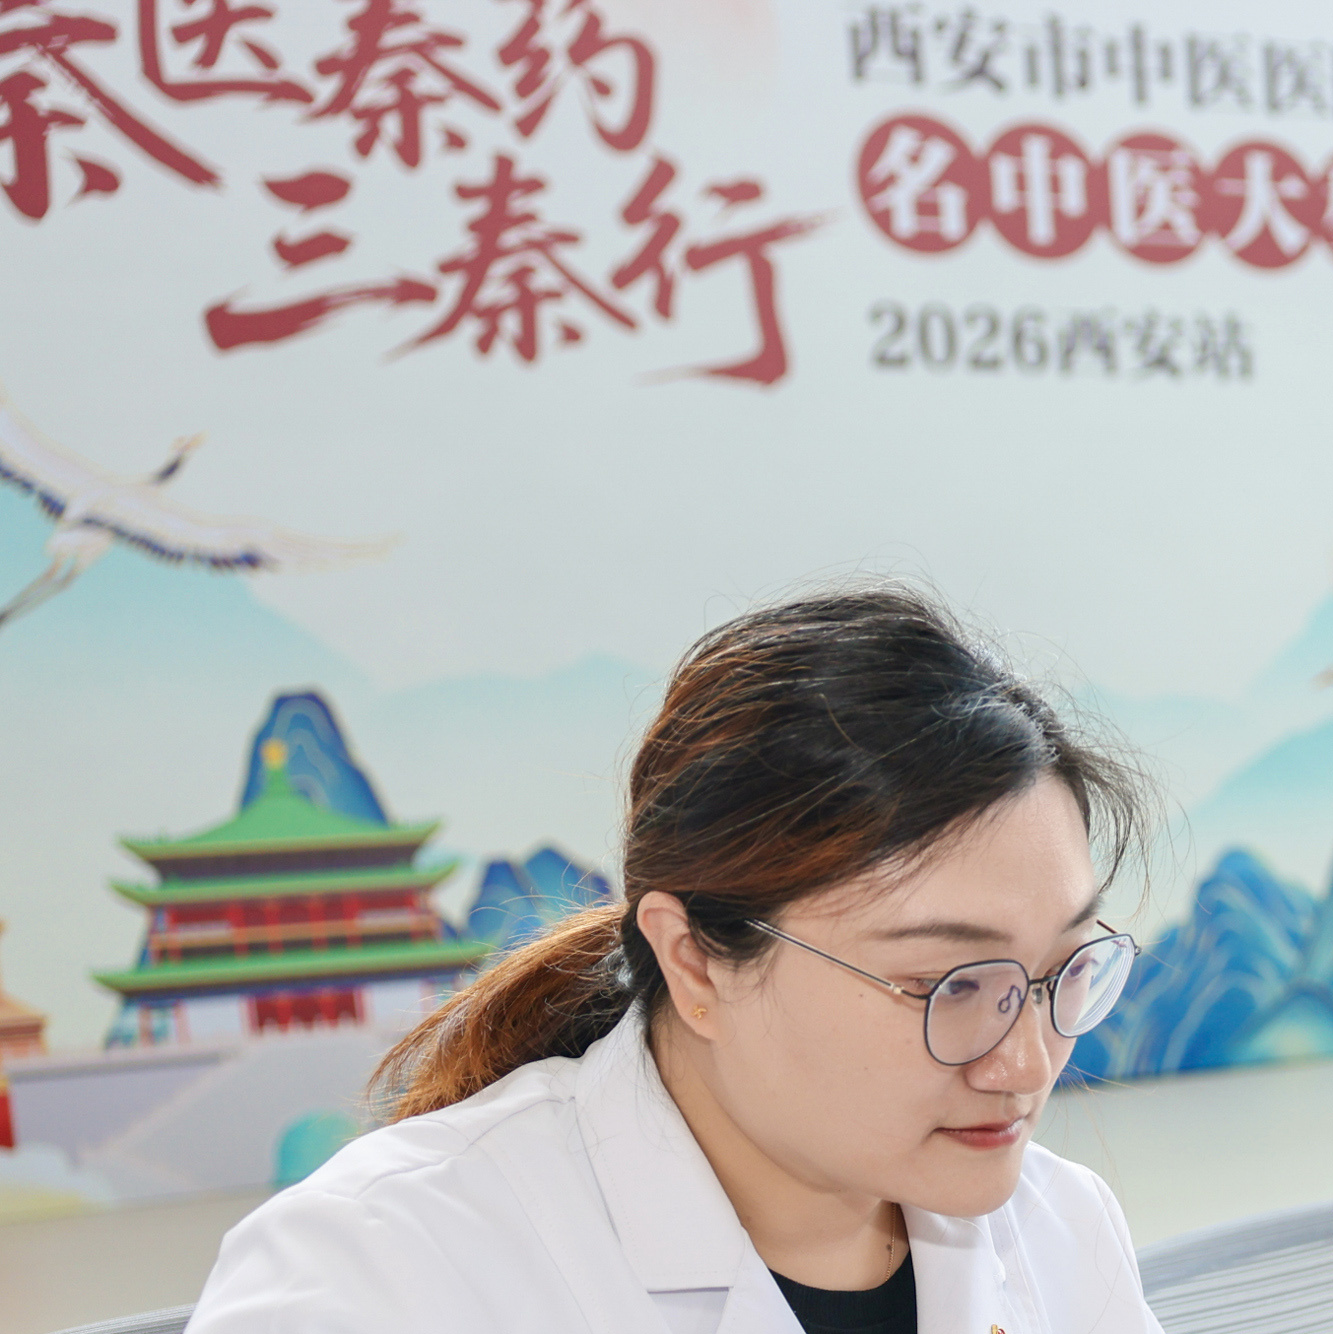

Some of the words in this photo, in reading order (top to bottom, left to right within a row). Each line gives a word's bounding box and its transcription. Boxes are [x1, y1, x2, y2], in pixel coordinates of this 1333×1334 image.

[204, 154, 836, 387] 三秦行
[868, 300, 1256, 382] 2026西安站
